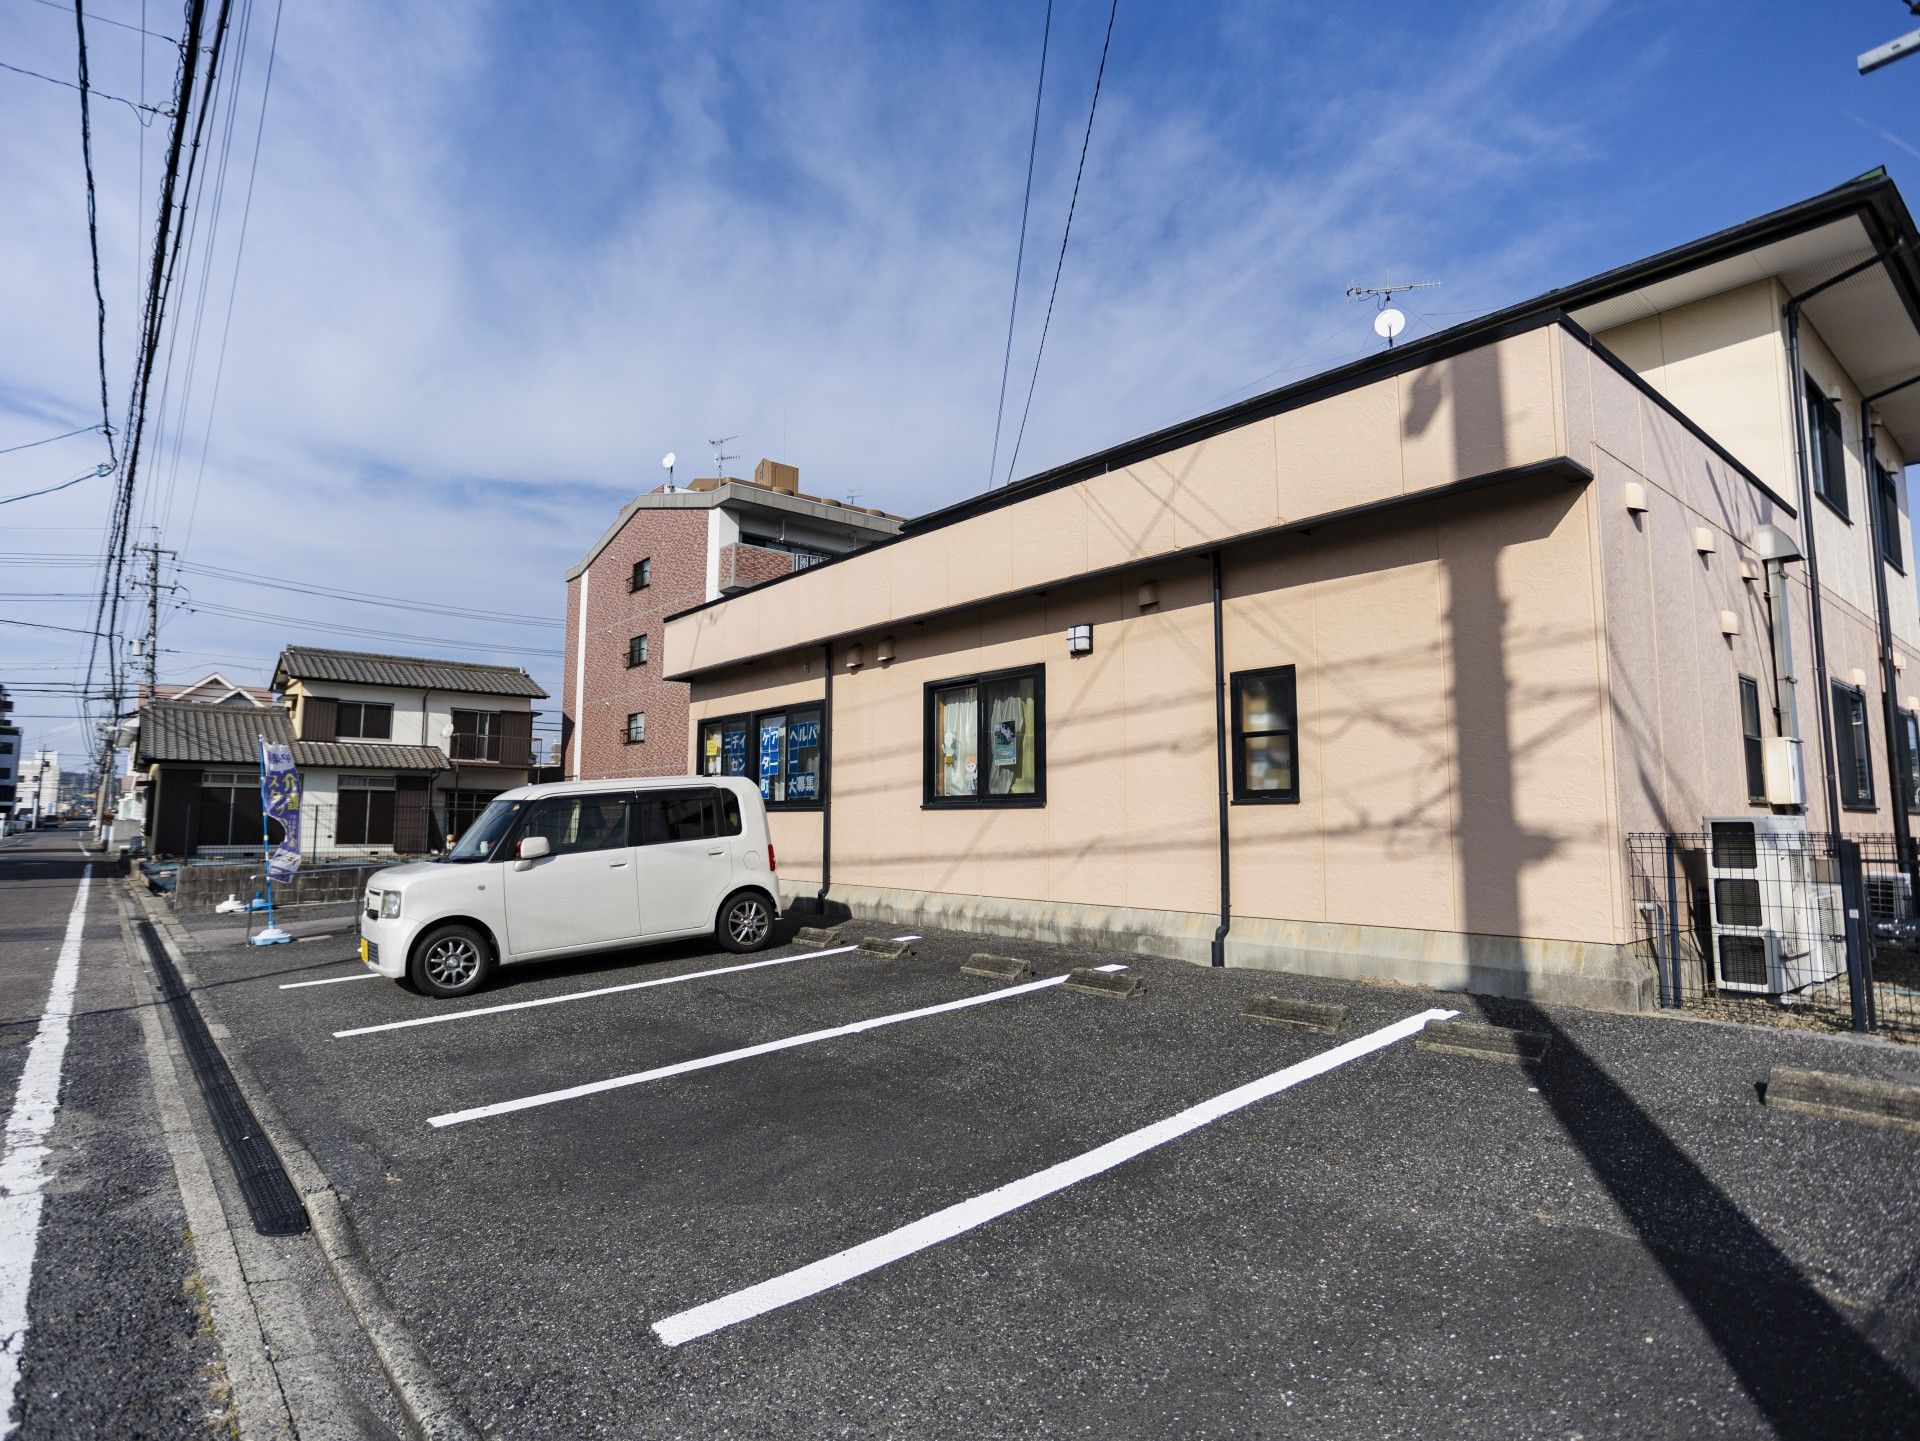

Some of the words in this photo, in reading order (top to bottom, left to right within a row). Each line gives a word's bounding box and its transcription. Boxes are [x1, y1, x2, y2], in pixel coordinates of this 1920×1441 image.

[790, 725, 817, 741] ヘルパ
[283, 773, 299, 809] 介護
[789, 776, 814, 794] 大募集
[269, 775, 287, 825] スタッ
